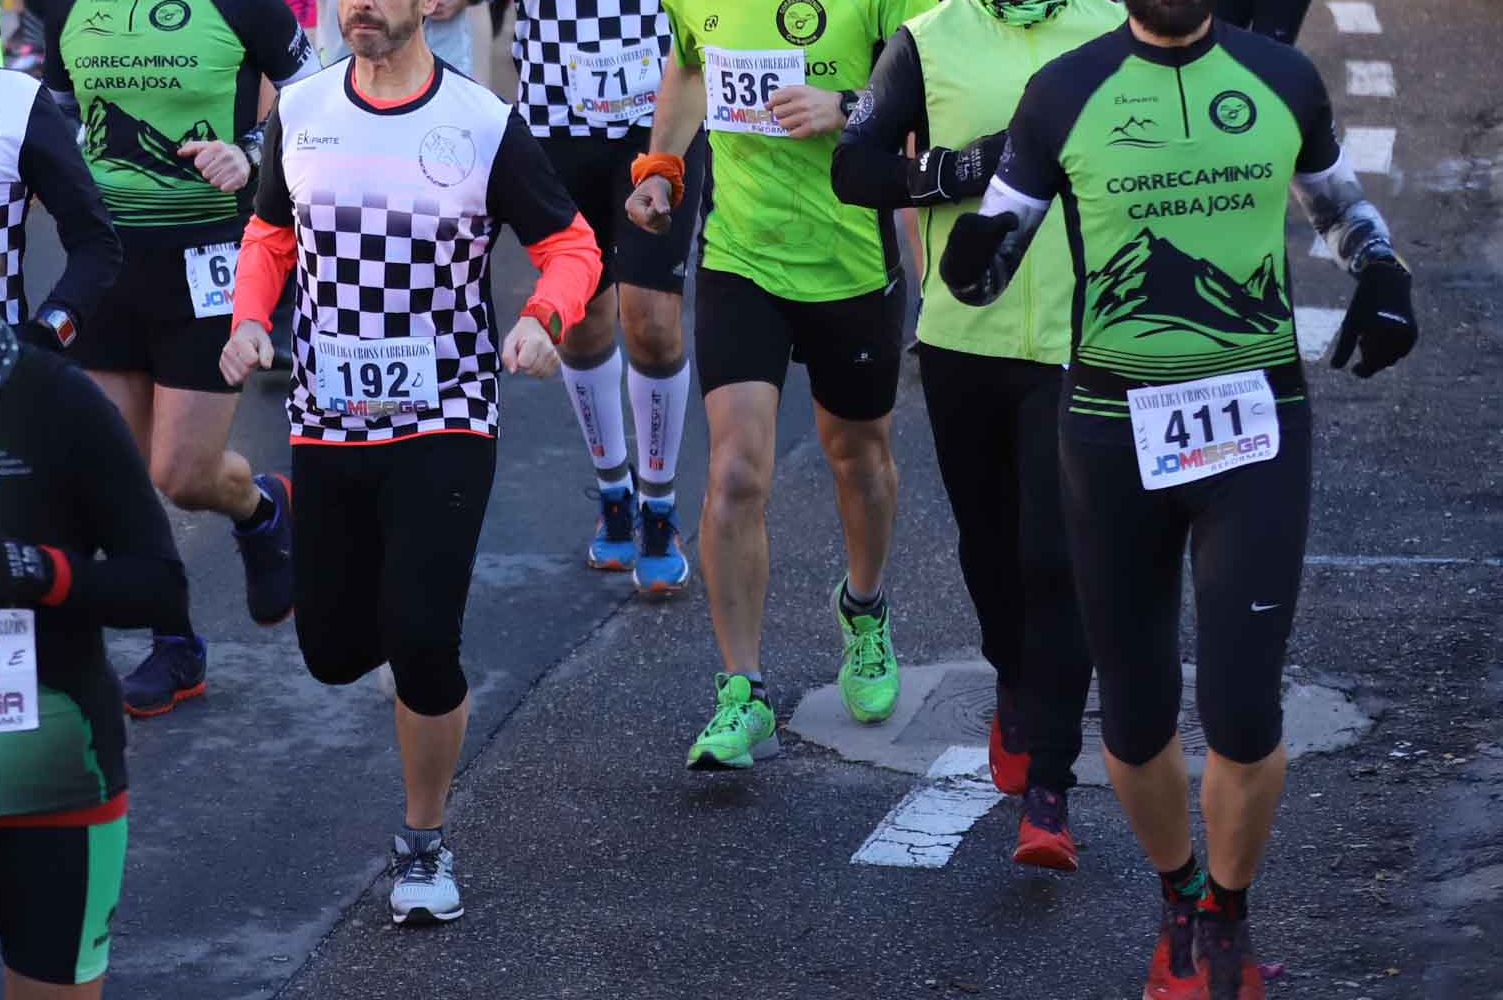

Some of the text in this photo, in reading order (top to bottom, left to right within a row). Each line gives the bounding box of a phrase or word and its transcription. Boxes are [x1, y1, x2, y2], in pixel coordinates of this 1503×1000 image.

[75, 55, 199, 70] CORRECAMINOS
[84, 76, 182, 91] CARBAJOSA
[591, 67, 629, 98] 71
[720, 71, 781, 107] 536
[1106, 162, 1274, 194] CORRECAMINOS
[1128, 193, 1256, 220] CARBAJOSA
[353, 345, 378, 360] CROSS
[380, 343, 430, 360] CABRERIZOS
[337, 362, 411, 398] 192
[1181, 386, 1211, 404] CROSS
[1211, 380, 1265, 399] CABRERIZOS
[1164, 399, 1243, 449] 411
[1152, 434, 1271, 476] JOMISAGA
